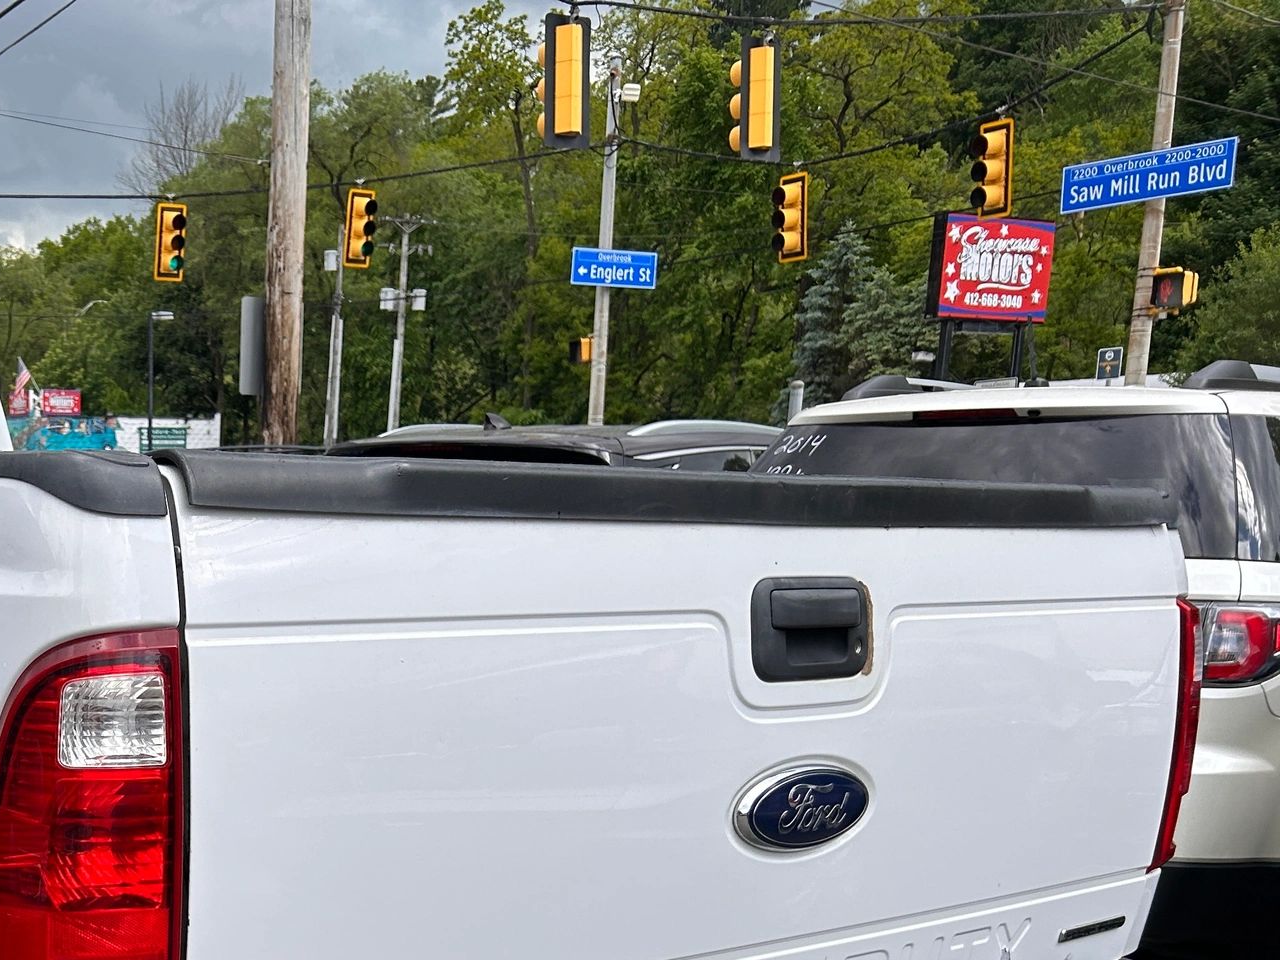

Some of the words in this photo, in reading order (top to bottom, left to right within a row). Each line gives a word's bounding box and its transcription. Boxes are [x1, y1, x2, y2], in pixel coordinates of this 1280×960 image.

[1073, 167, 1098, 180] 2200
[1104, 156, 1158, 174] Overbrook
[1165, 144, 1224, 164] 2200-2000
[1070, 182, 1103, 204] Saw
[1110, 173, 1140, 197] Mill
[1147, 170, 1180, 191] Run
[1188, 159, 1227, 184] Blvd
[598, 252, 632, 263] Overbrook
[957, 225, 1040, 263] Showcase
[590, 264, 634, 284] Englert
[639, 267, 651, 282] St
[964, 292, 1023, 309] 412-668-3040
[773, 434, 827, 457] 2014
[777, 782, 851, 835] Ford
